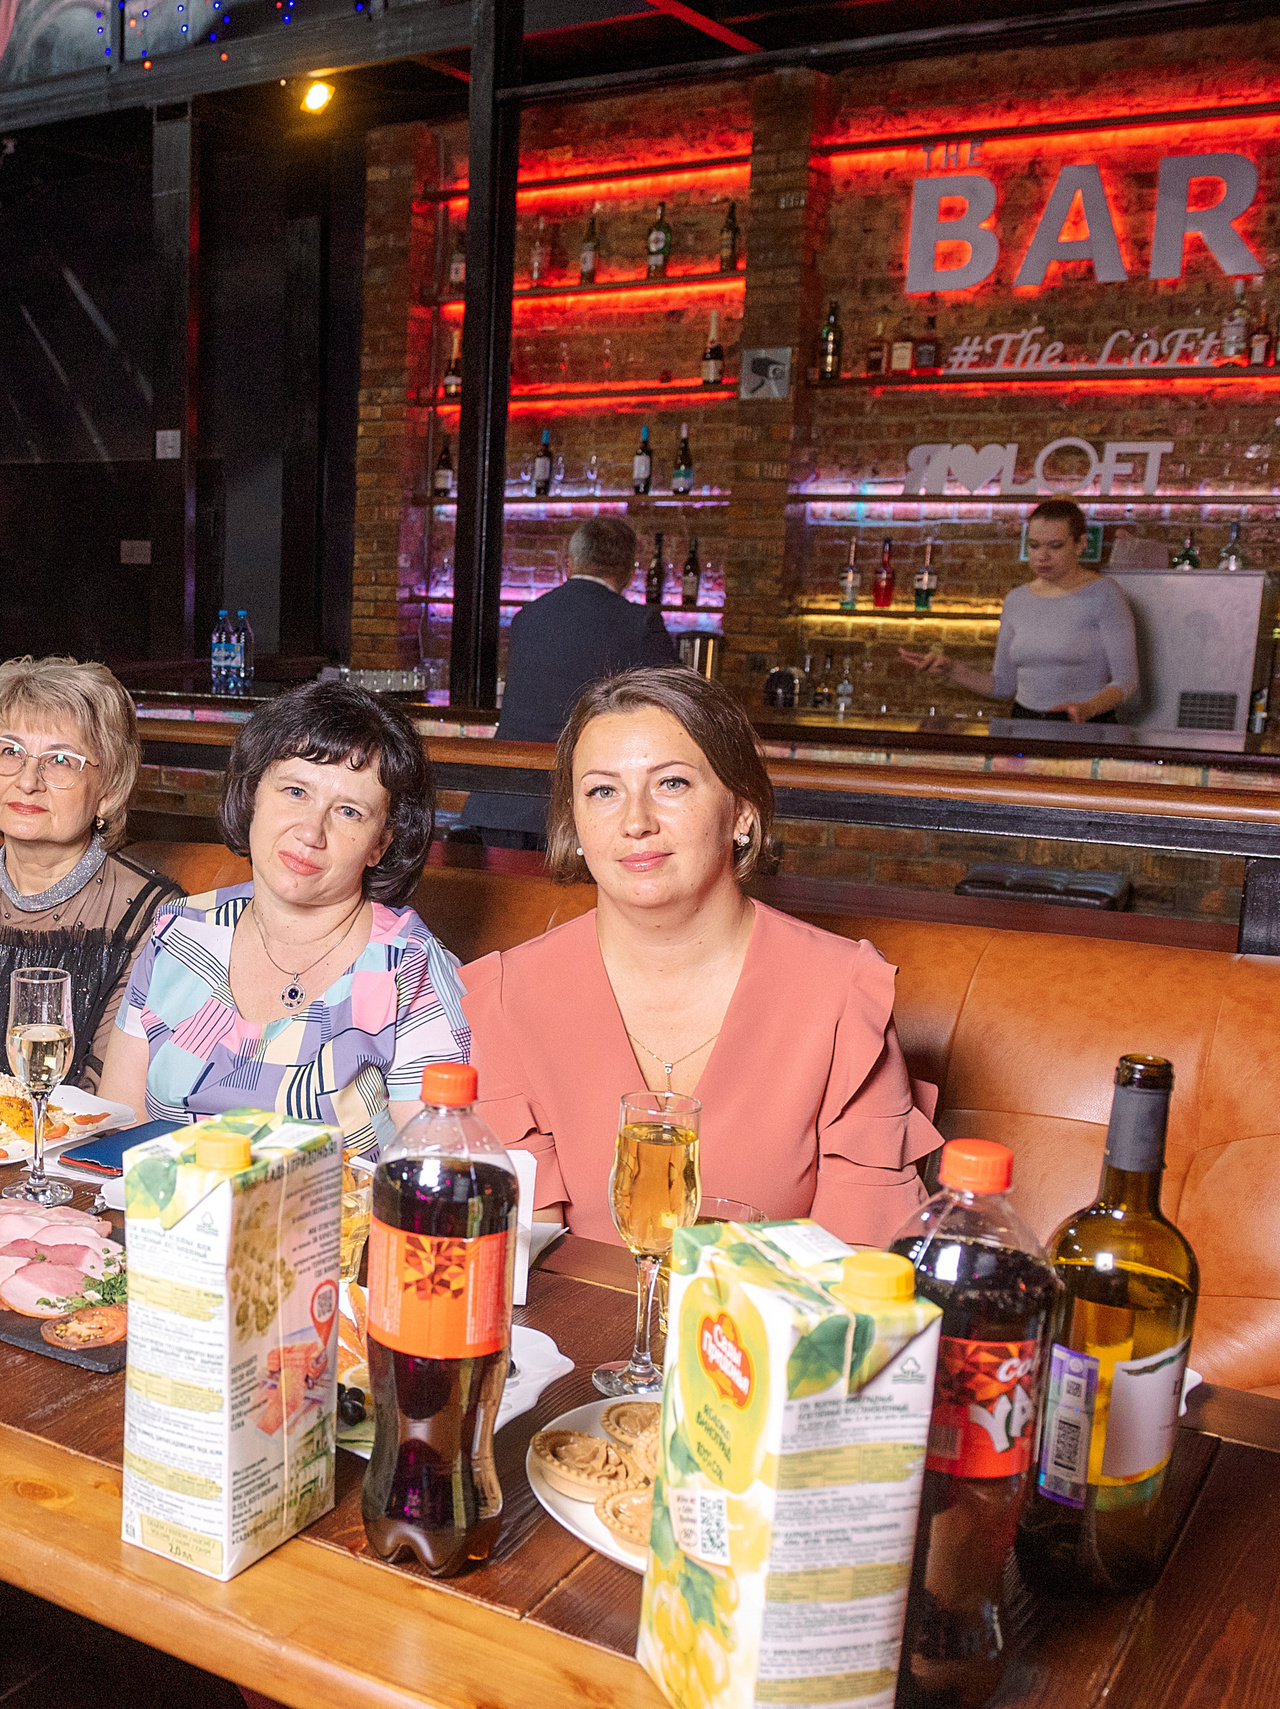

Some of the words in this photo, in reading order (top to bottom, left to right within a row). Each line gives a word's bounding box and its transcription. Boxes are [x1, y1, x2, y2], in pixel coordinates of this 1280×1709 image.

[922, 141, 984, 169] THE
[905, 152, 1265, 293] BAR
[947, 327, 1064, 373] #The
